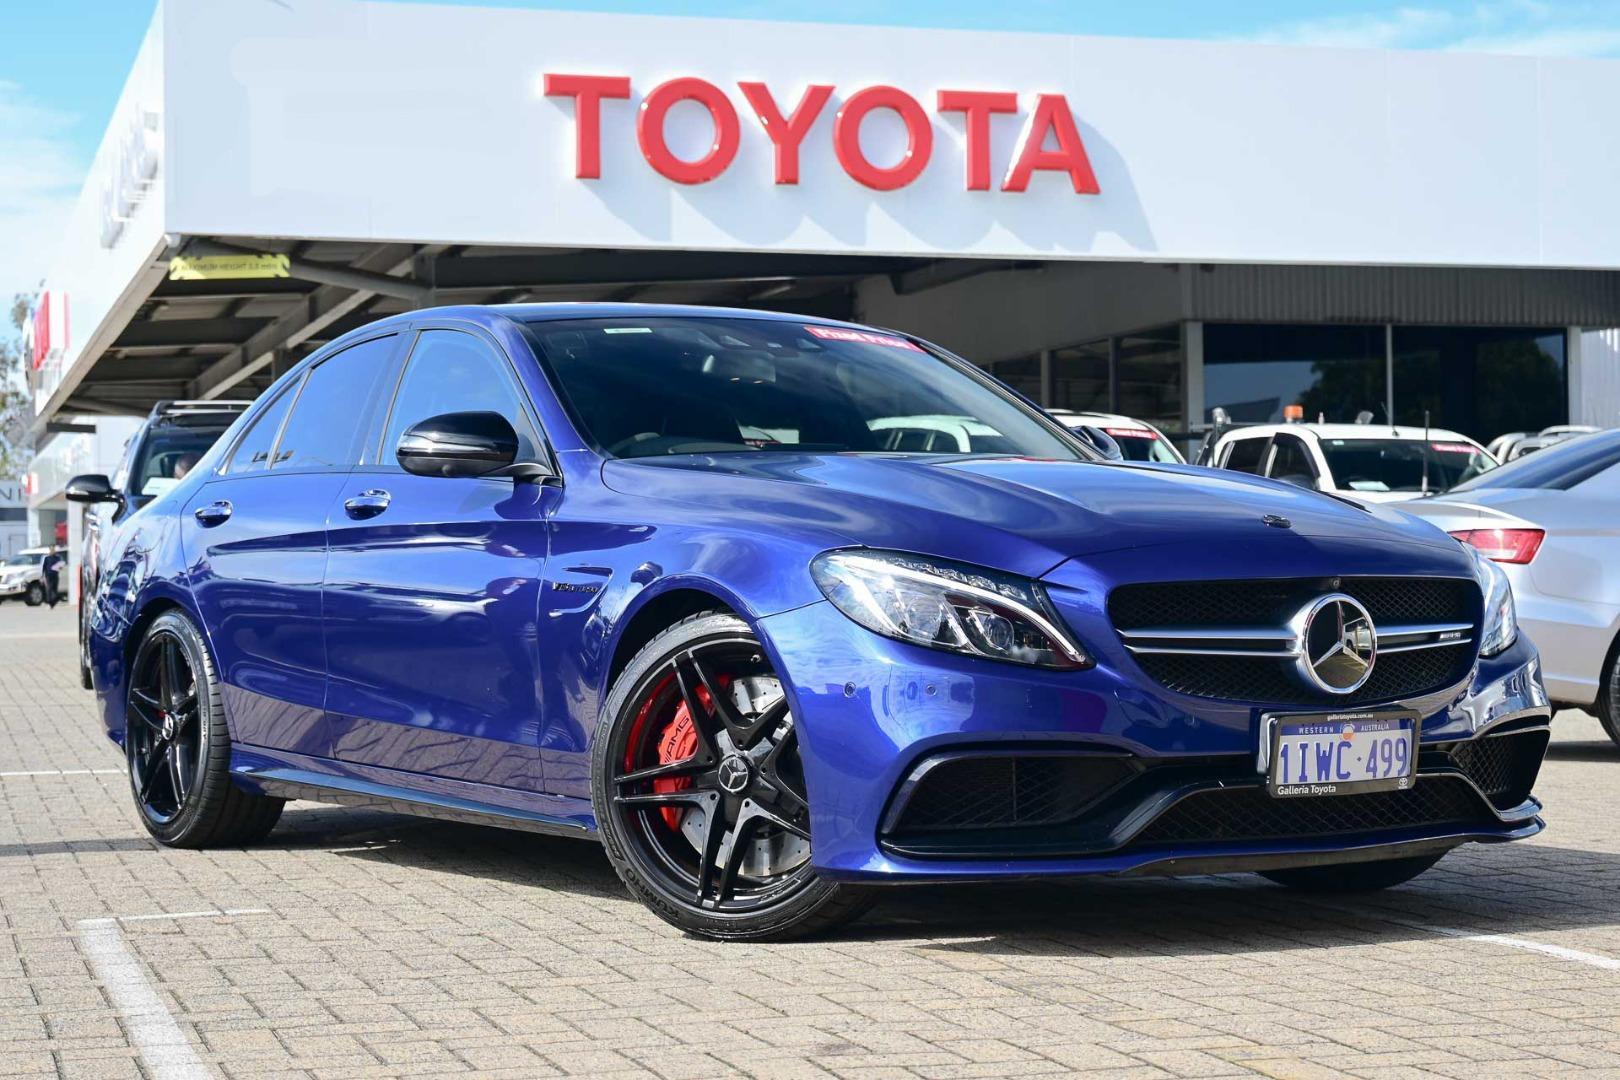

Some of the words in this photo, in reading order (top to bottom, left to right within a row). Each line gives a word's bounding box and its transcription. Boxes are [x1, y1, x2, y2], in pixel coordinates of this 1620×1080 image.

[543, 73, 1101, 195] TOYOTA
[666, 715, 690, 758] AMG
[1298, 726, 1334, 734] WESTERN
[1360, 723, 1390, 731] AUSTRALIA
[1277, 784, 1309, 795] Galleria
[1311, 784, 1336, 796] Toyota
[624, 868, 680, 920] KUMHO
